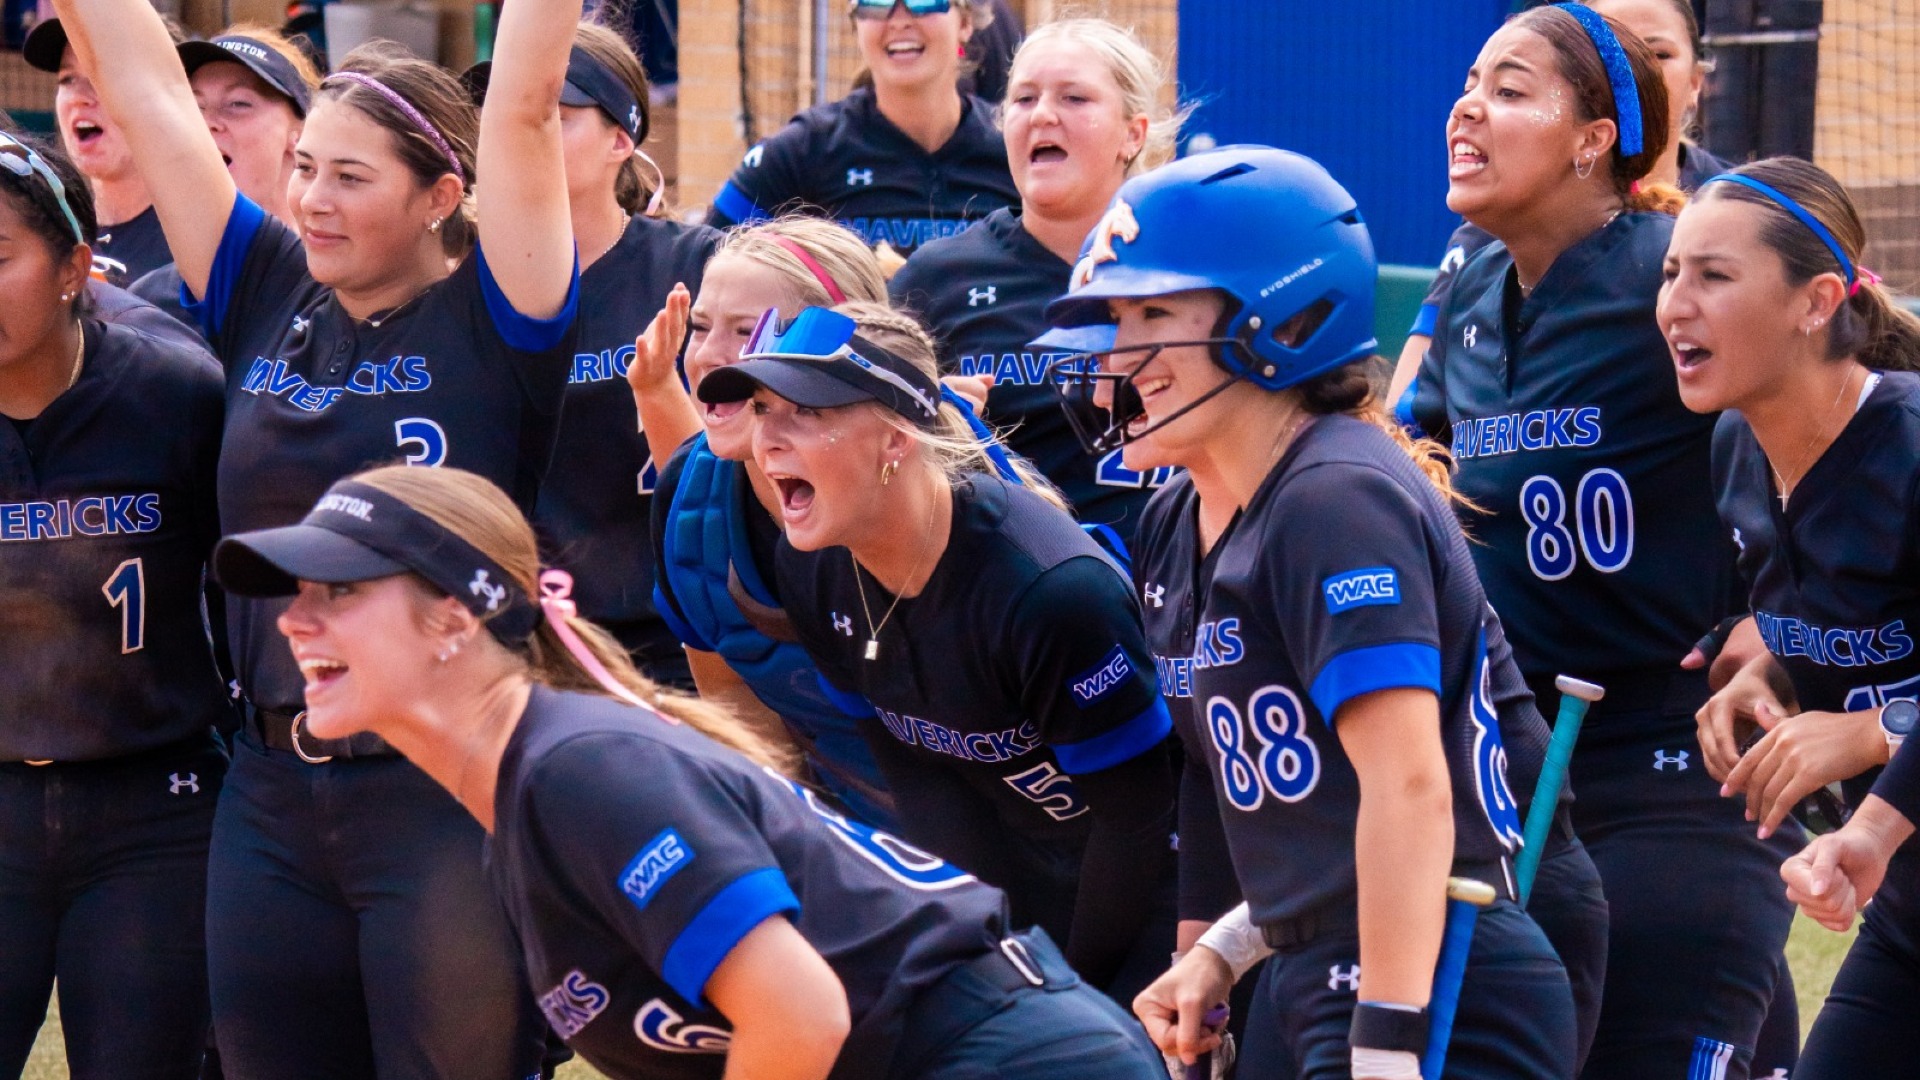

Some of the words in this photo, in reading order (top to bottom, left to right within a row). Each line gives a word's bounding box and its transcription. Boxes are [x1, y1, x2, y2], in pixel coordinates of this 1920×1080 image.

[1519, 467, 1635, 582] 80
[101, 557, 145, 655] 1
[1326, 573, 1395, 605] WAC
[1073, 652, 1129, 700] WAC
[1206, 684, 1321, 812] 88
[1002, 761, 1091, 822] 5
[623, 833, 685, 899] WAC
